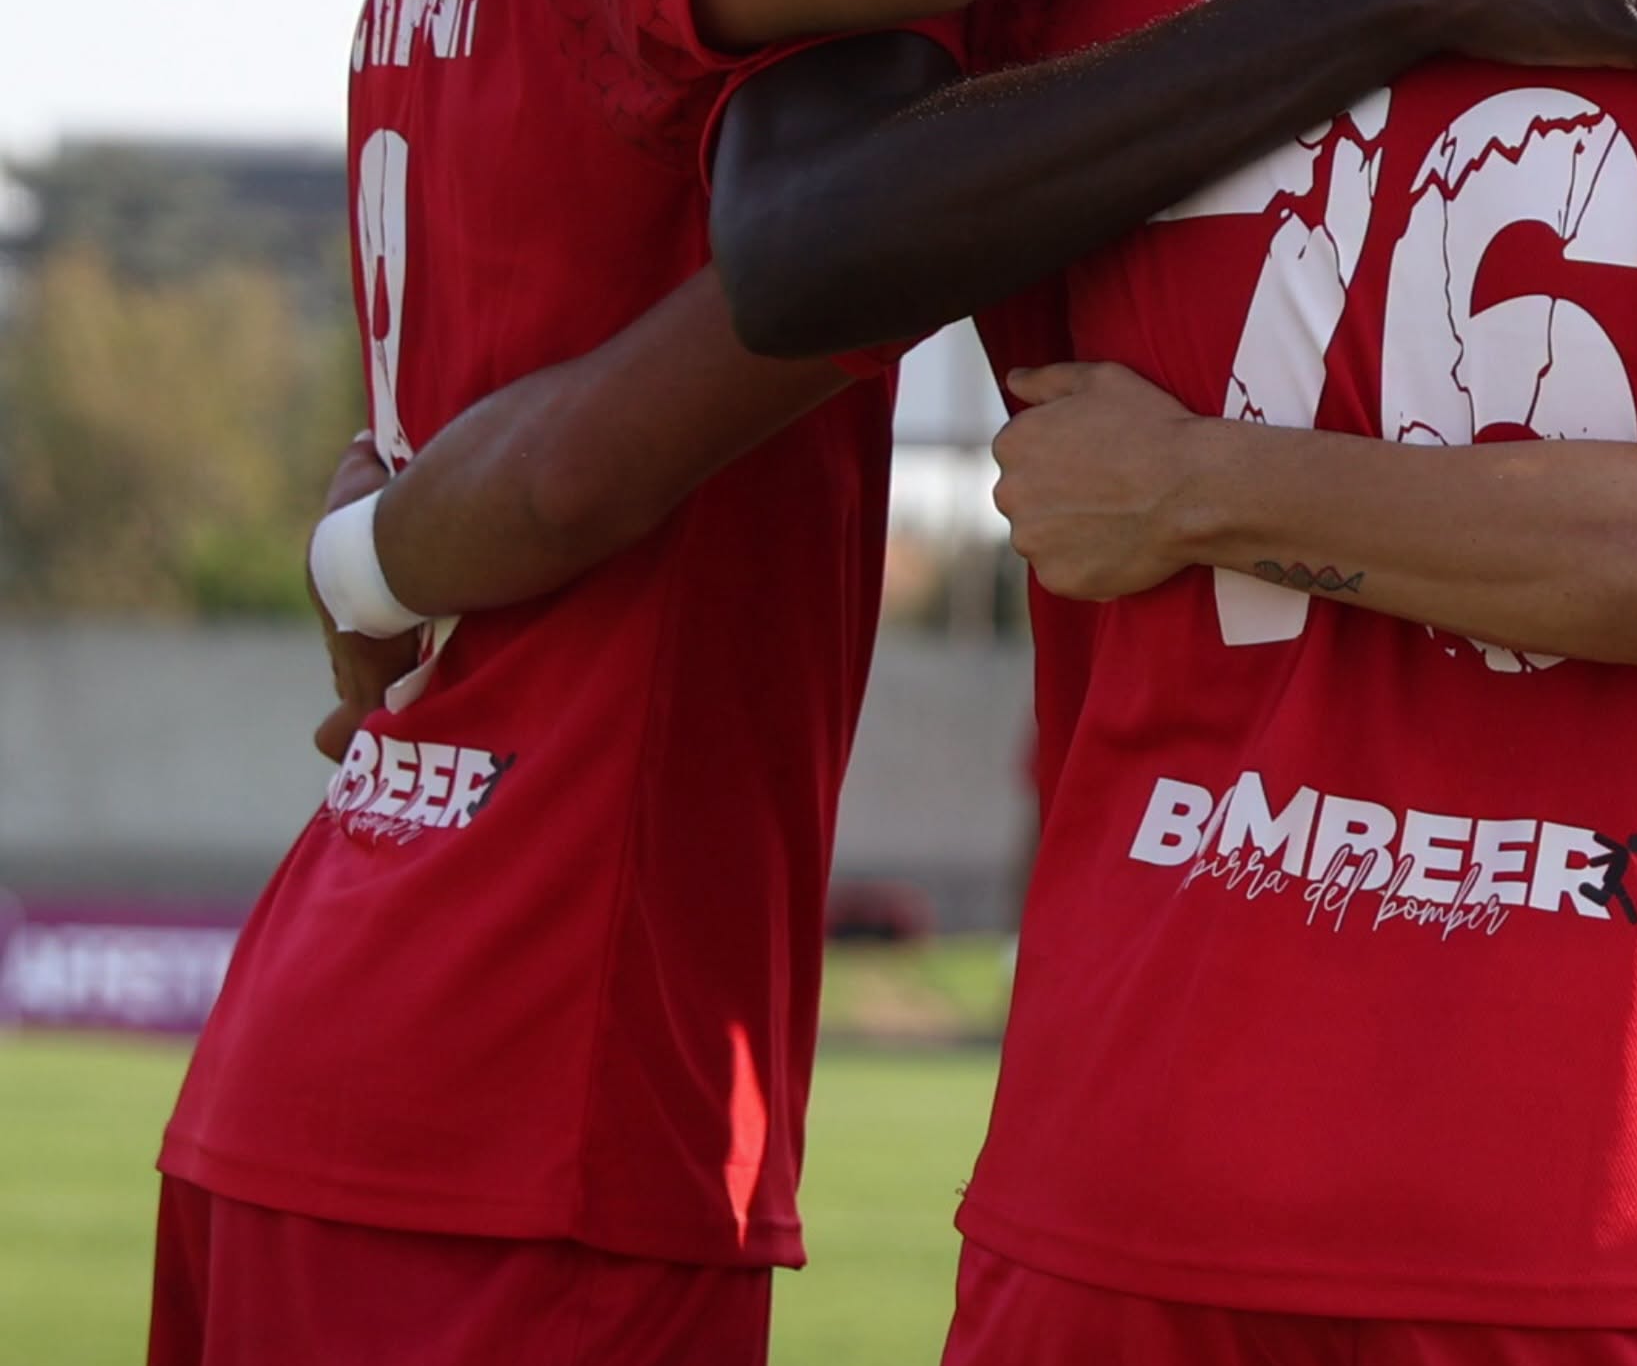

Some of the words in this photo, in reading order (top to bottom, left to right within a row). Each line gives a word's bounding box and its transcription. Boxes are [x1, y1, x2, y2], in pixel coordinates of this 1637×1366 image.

[1128, 771, 1612, 920] BMBEER
[1304, 843, 1377, 933] del
[1372, 855, 1510, 942] bomber
